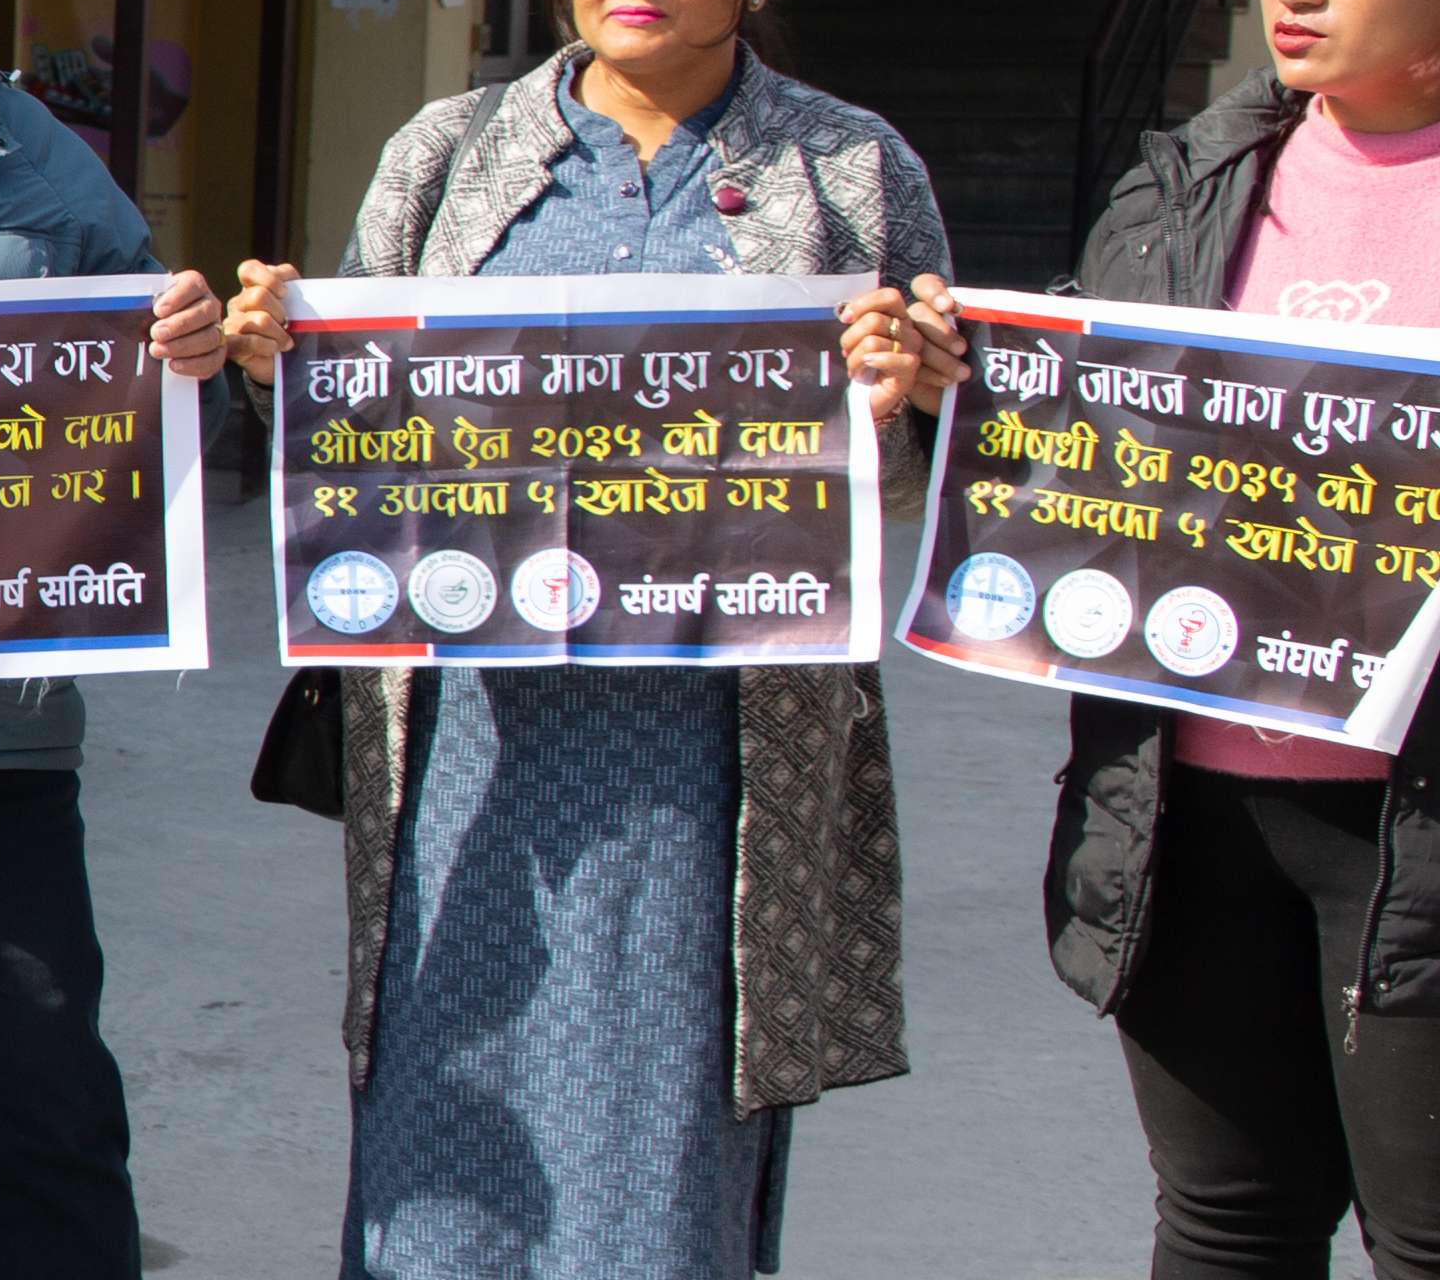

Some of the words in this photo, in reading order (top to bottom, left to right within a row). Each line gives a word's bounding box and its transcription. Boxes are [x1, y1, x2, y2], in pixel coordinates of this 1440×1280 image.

[52, 340, 115, 383] गर
[306, 340, 393, 408] हाम्रो
[407, 353, 525, 398] जायज
[540, 353, 625, 395] माग
[633, 351, 712, 409] पुरा
[727, 348, 794, 391] गर
[982, 337, 1063, 402] हाम्रो
[1075, 360, 1188, 415] जायज
[1202, 378, 1288, 430] माग
[1292, 391, 1376, 456] पुरा
[64, 410, 135, 449] दफा
[311, 415, 435, 464] औषधी
[452, 416, 513, 470] ऐन
[531, 423, 641, 462] २०३५
[662, 408, 721, 457] को
[737, 421, 823, 458] दफा
[50, 469, 106, 504] गर
[977, 409, 1100, 472] औषधी
[1114, 427, 1172, 489] ऐन
[1187, 454, 1297, 504] २०३५
[1317, 463, 1377, 516] को
[315, 486, 357, 517] ११
[381, 481, 508, 517] उपदफा
[575, 466, 708, 517] खारेज
[726, 477, 791, 513] गर
[970, 480, 1013, 518] ११
[1030, 488, 1164, 542] उपदफा
[1225, 515, 1358, 574] खारेज
[37, 562, 146, 608] समिति
[618, 572, 711, 616] संघर्ष
[715, 572, 830, 617] समिति
[1256, 630, 1349, 682] संघर्ष
